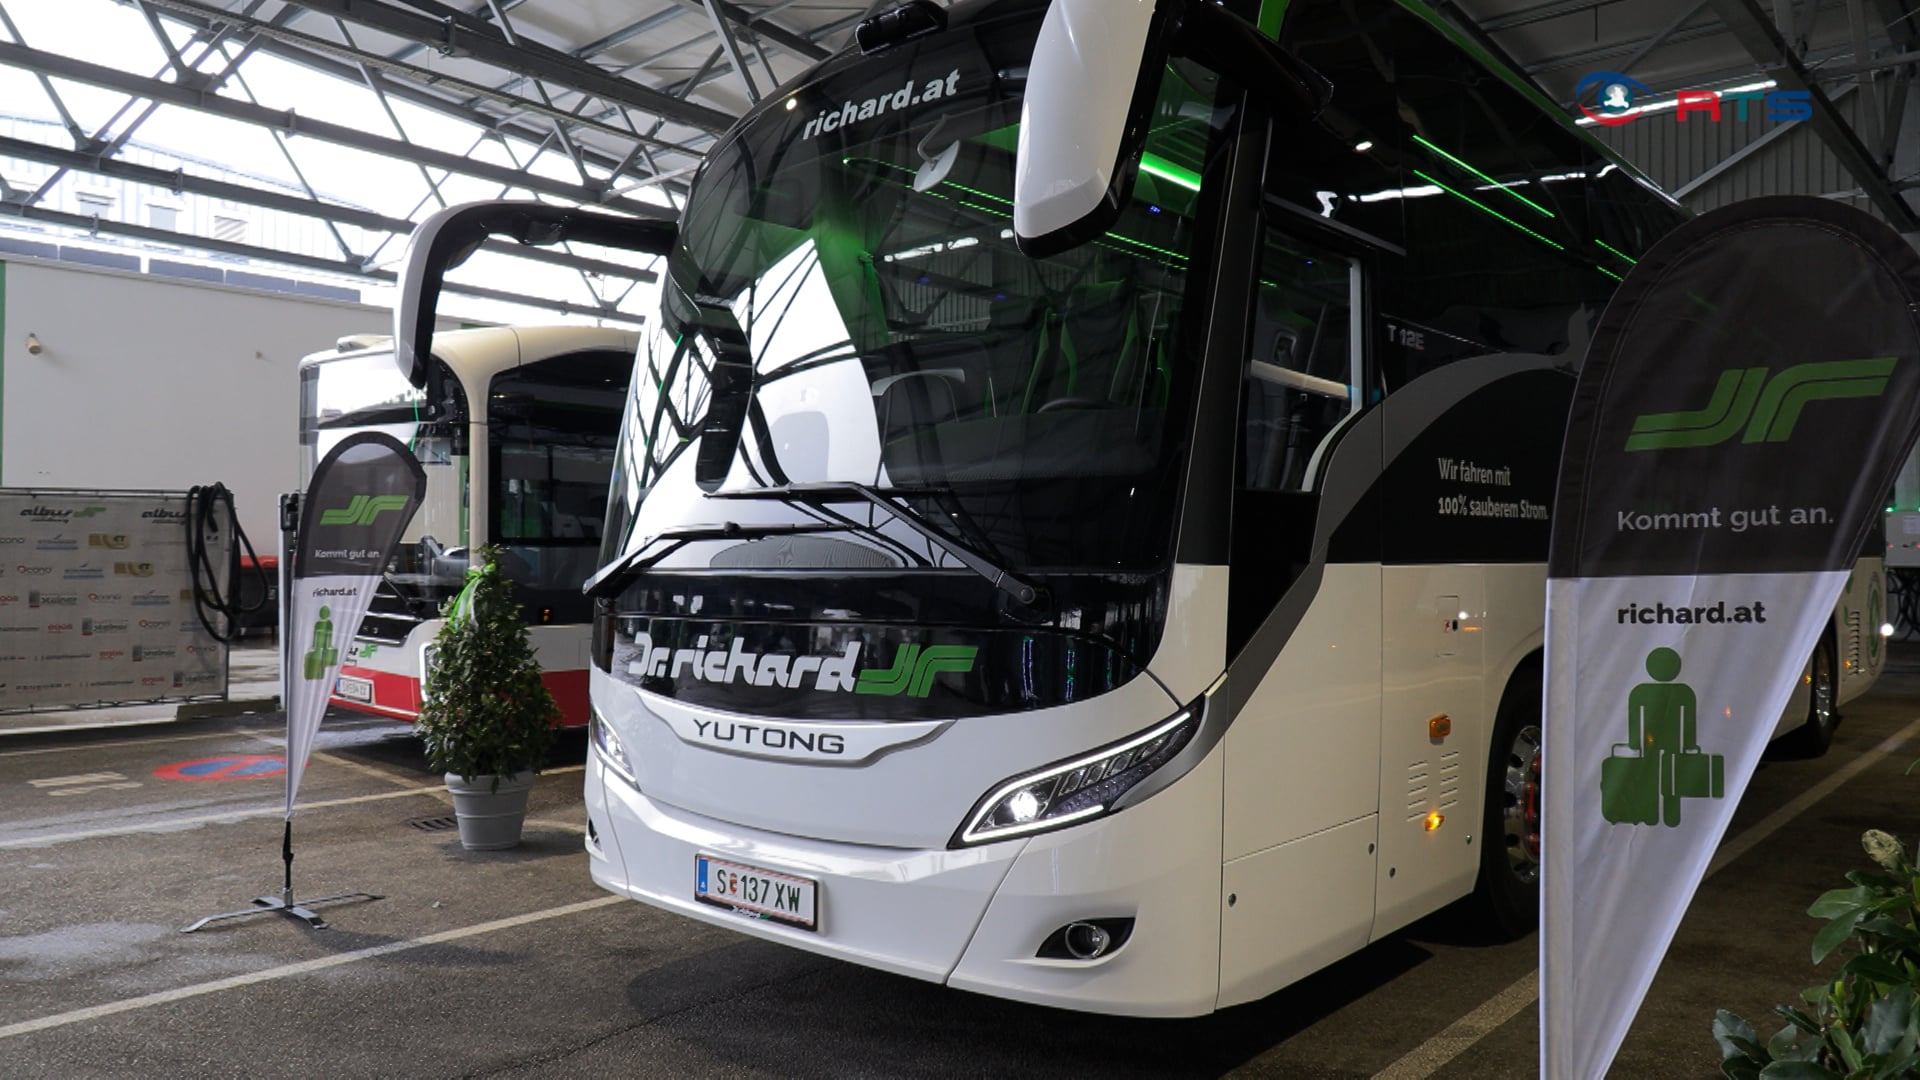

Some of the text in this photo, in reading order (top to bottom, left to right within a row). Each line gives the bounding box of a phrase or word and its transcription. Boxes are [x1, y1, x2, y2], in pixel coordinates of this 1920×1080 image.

[803, 68, 960, 140] richard.at
[1437, 457, 1511, 486] Wir fahren mit
[1438, 493, 1549, 520] 100% sauberem Strom.
[1617, 505, 1834, 533] Kommt gut an.
[314, 549, 347, 559] Kommt
[348, 549, 366, 560] gut
[312, 587, 357, 598] richard.at
[1617, 601, 1767, 624] richard.at
[693, 719, 845, 755] YUTONG
[716, 868, 727, 894] S
[740, 874, 771, 904] 137
[774, 881, 801, 913] XW
